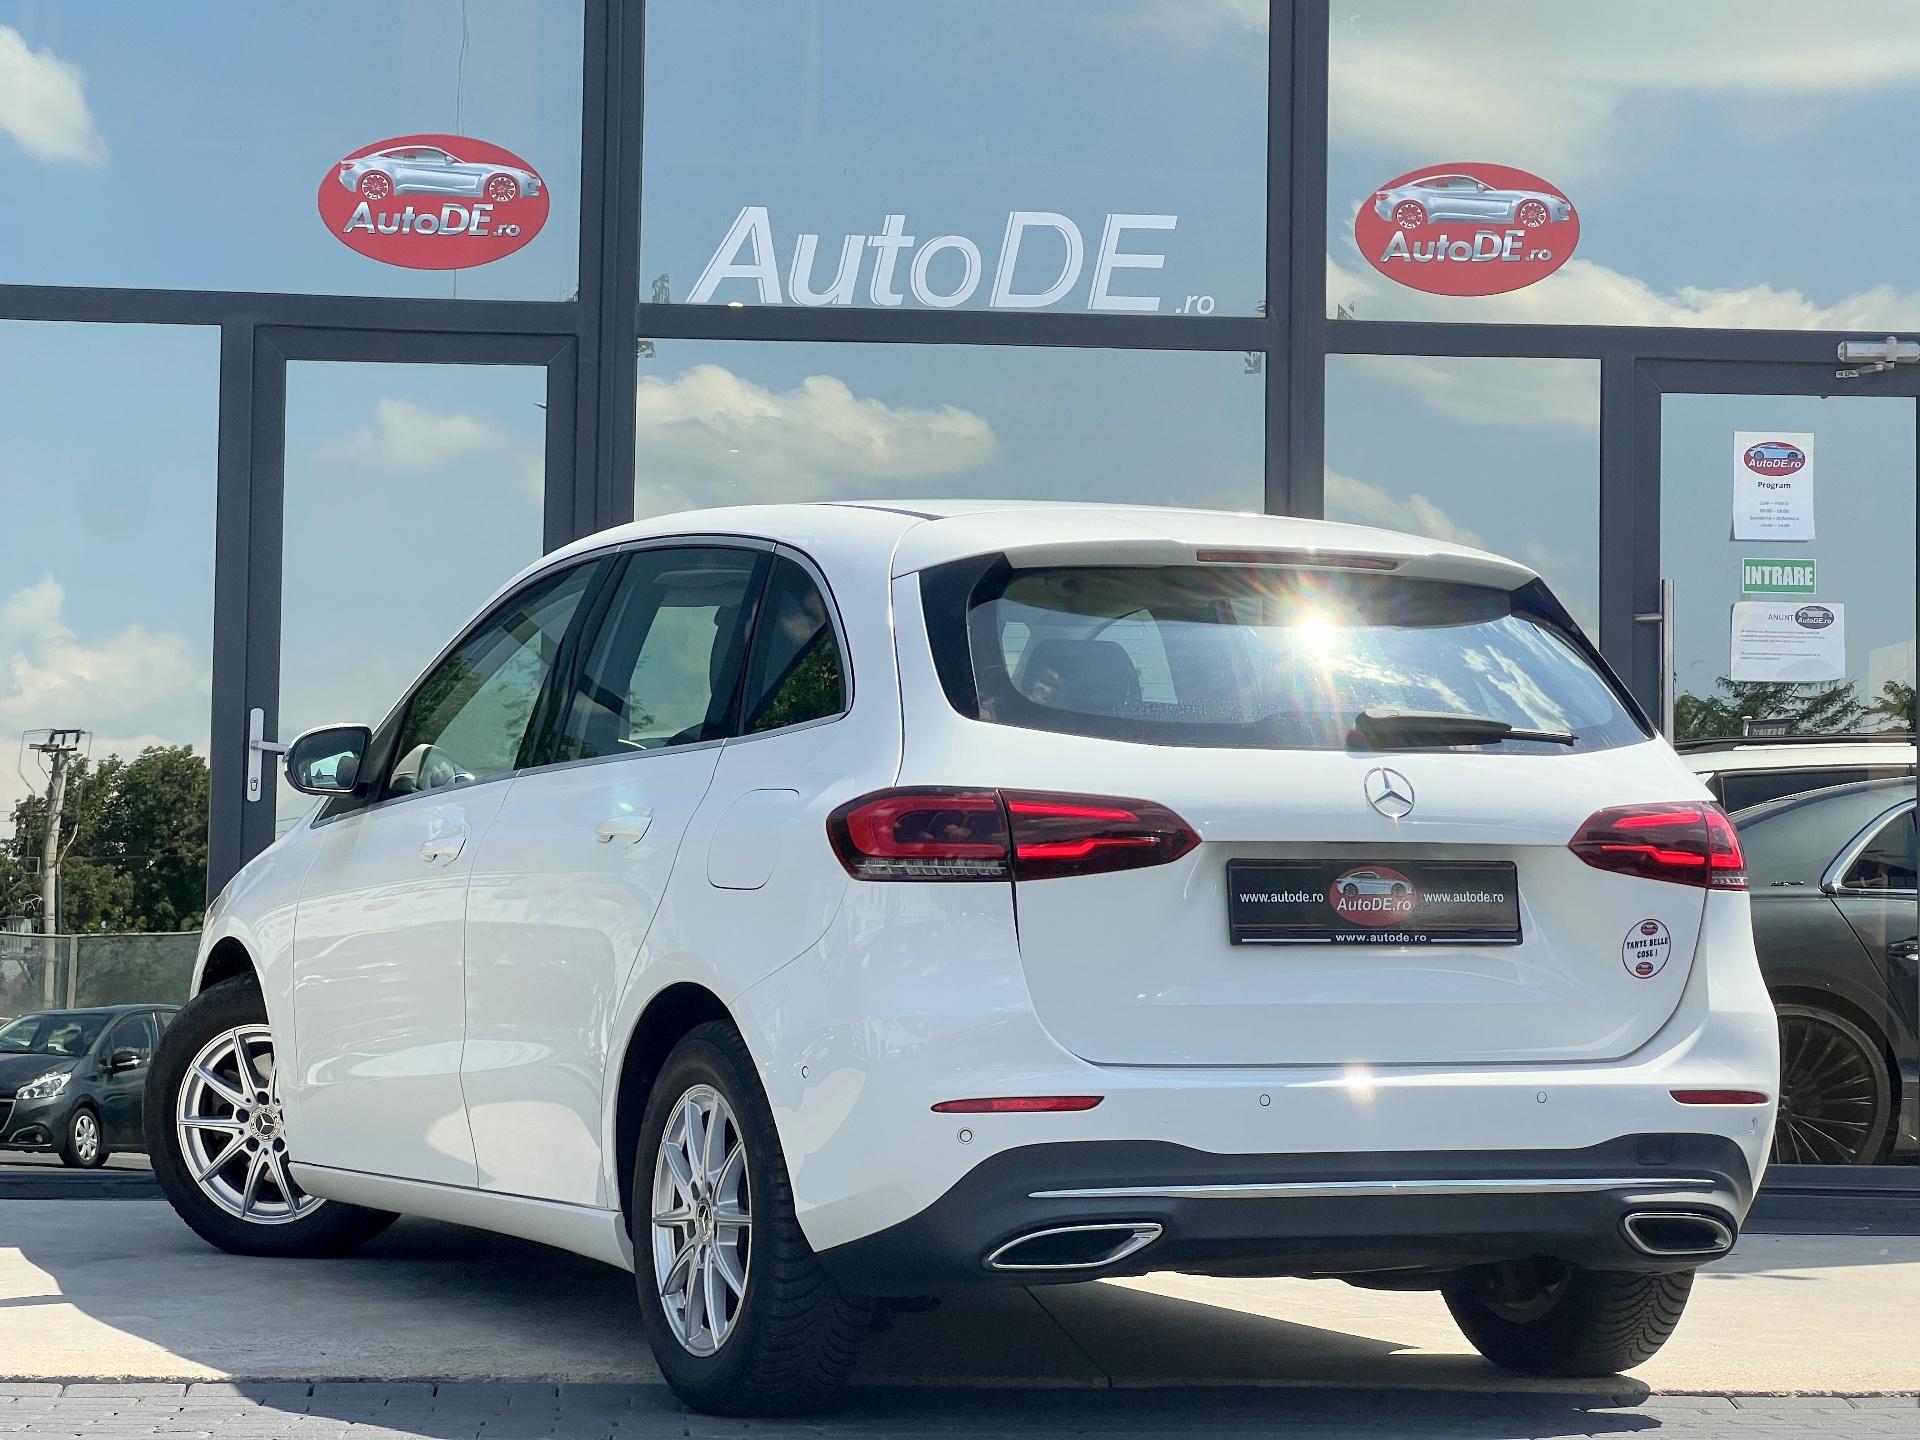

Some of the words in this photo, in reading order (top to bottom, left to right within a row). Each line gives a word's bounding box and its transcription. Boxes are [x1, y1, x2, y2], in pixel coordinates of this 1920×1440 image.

[1748, 459, 1802, 468] AutoDE.ro
[1757, 481, 1791, 490] Program
[1745, 565, 1814, 586] INTRARE
[1240, 891, 1324, 903] www.autode.ro
[1424, 891, 1504, 903] www.autode.ro
[1336, 897, 1412, 912] AutoDE.ro
[1336, 932, 1427, 943] www.autode.ro
[1626, 940, 1647, 949] TANTE
[1649, 937, 1668, 946] BELLE
[1637, 950, 1653, 958] COSE
